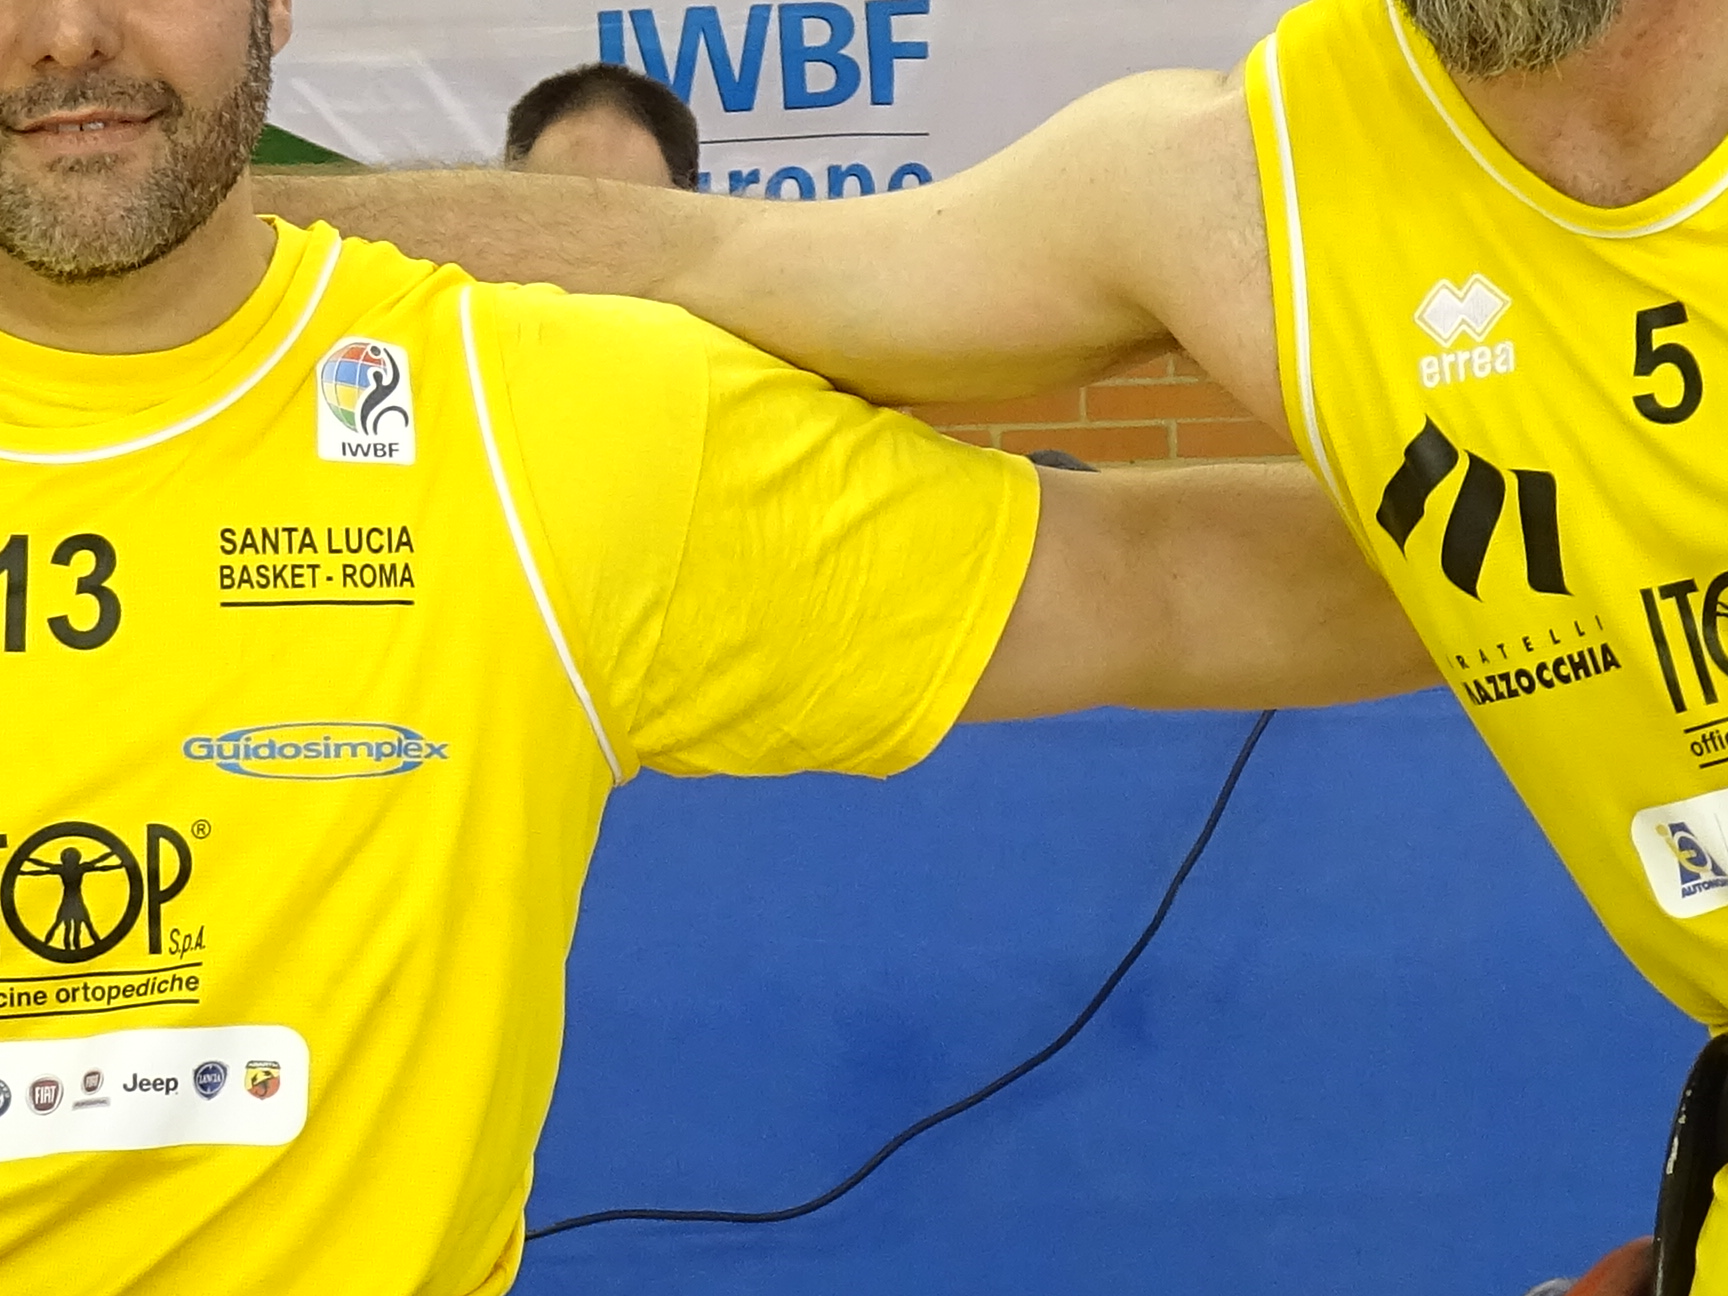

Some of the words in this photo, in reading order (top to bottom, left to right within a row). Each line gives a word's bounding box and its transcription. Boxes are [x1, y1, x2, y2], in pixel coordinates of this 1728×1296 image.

[1632, 300, 1703, 425] 5
[341, 441, 400, 458] IWBF
[220, 527, 318, 555] SANTA
[327, 526, 414, 554] LUCIA
[219, 564, 321, 590] BASKET
[342, 563, 415, 589] ROMA
[182, 736, 449, 762] Guidosimplex
[56, 974, 200, 1005] ortopediche
[34, 1085, 57, 1105] FIAT
[122, 1073, 179, 1095] Jeep
